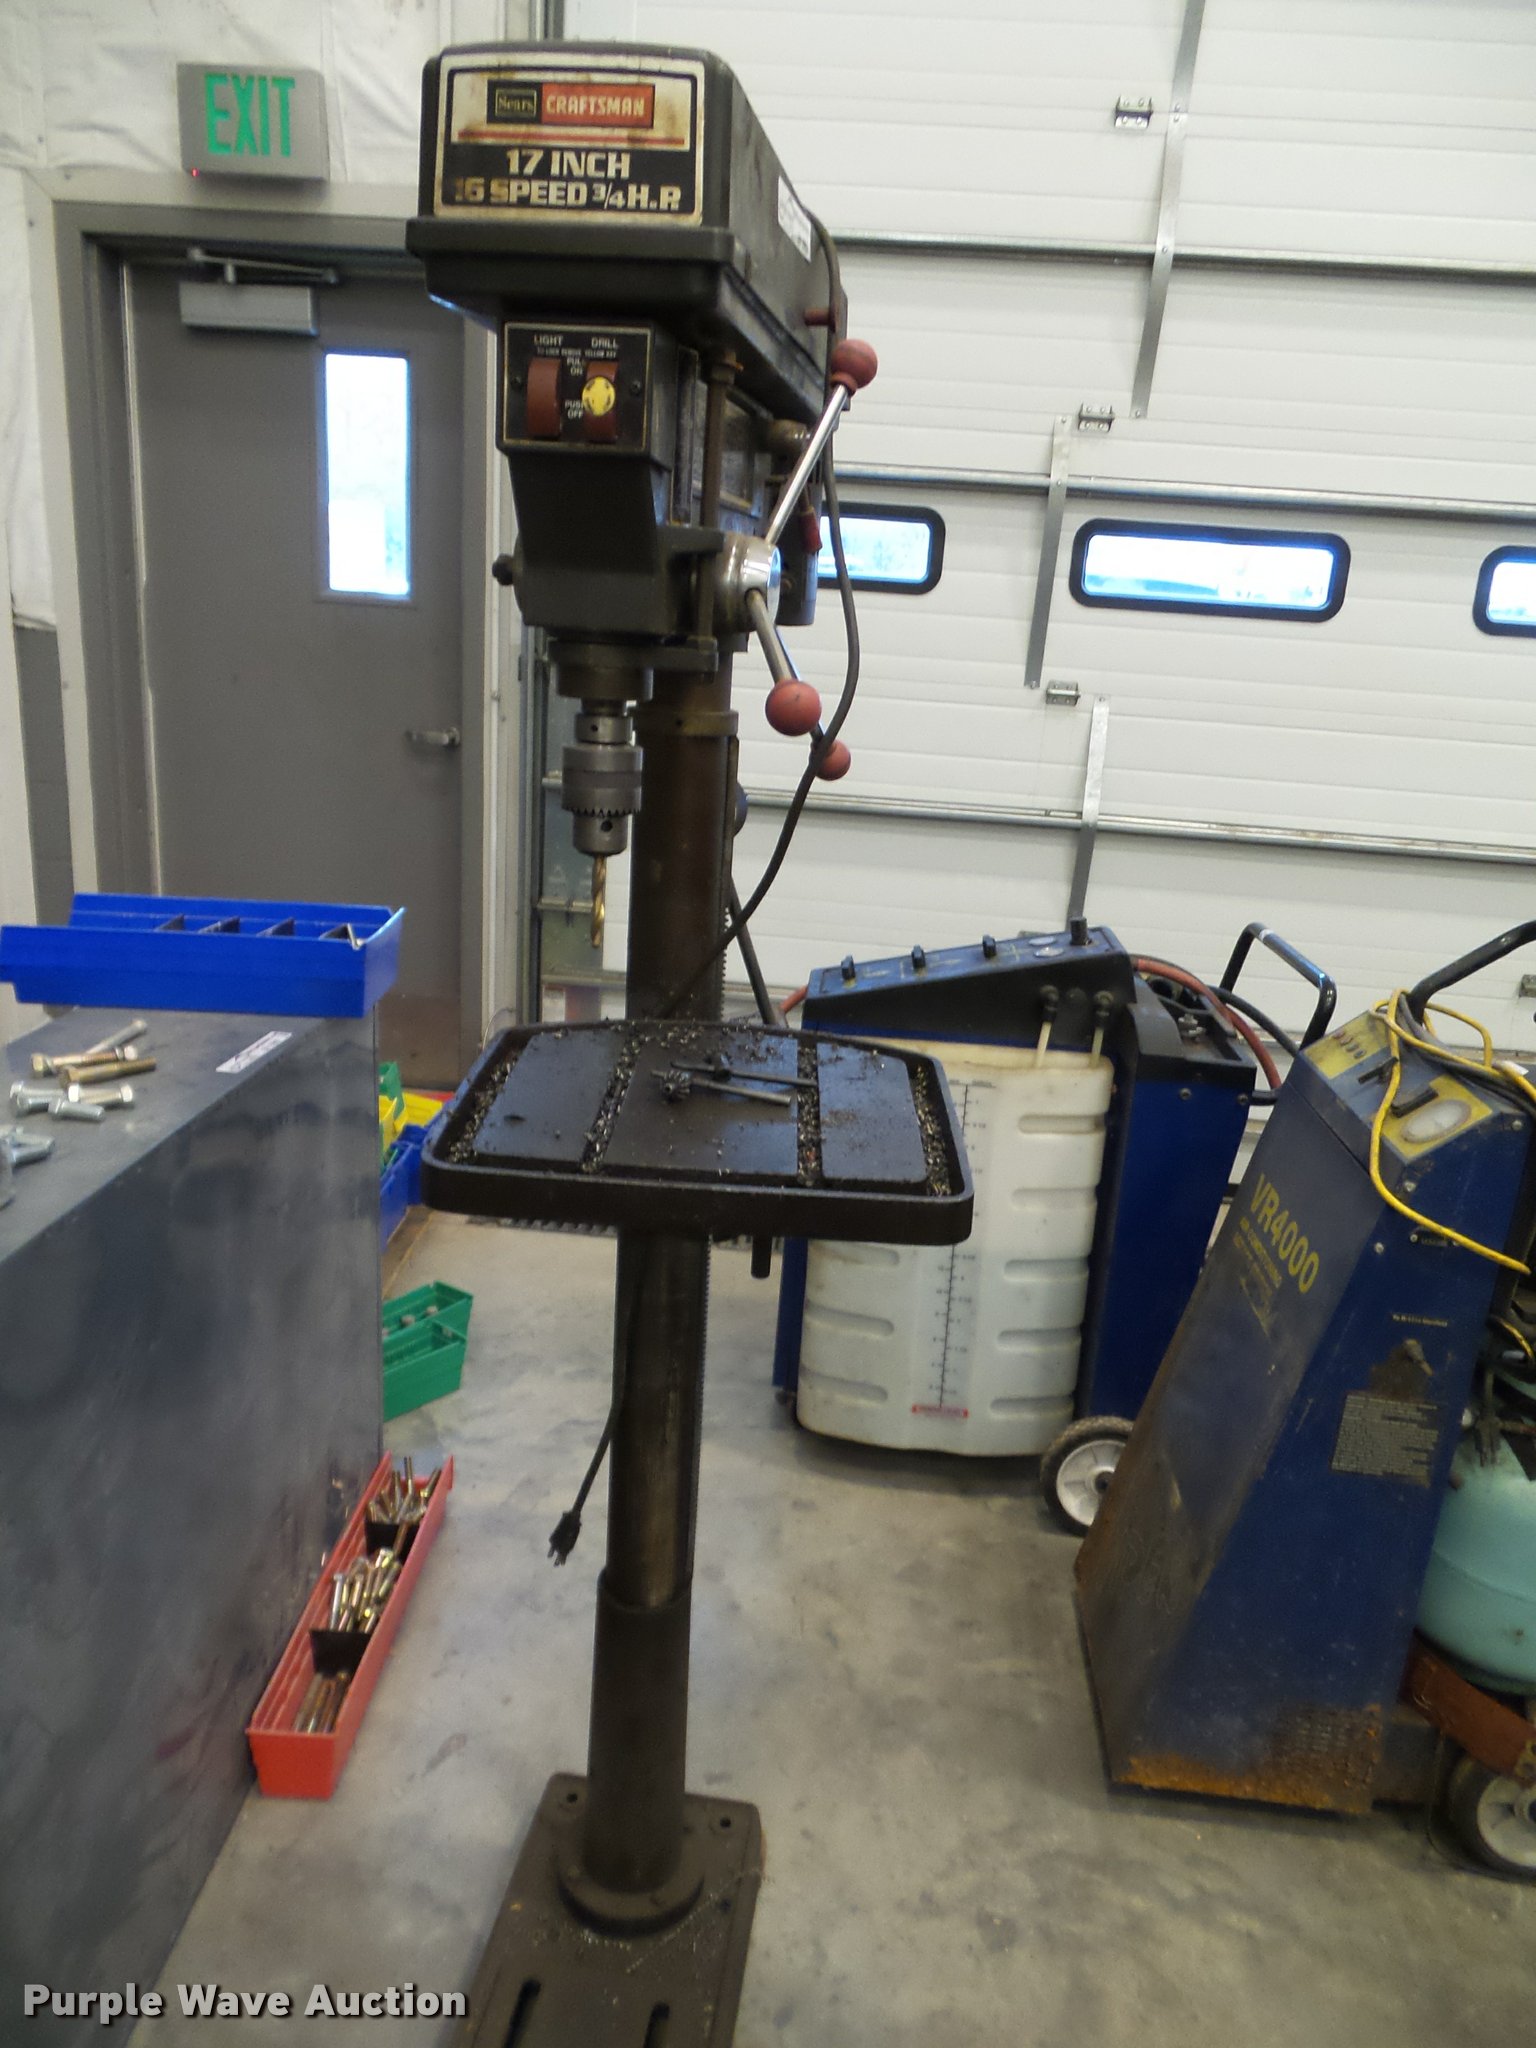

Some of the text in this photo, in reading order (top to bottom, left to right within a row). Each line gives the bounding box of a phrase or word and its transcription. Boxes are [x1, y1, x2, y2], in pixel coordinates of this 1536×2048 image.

[204, 72, 296, 157] EXIT
[498, 94, 645, 116] Sears CRAFTSMAN
[506, 150, 631, 179] 17 INCH
[490, 178, 588, 207] SPEED
[534, 335, 563, 346] LIGHT
[591, 337, 618, 349] DRILL
[570, 367, 583, 376] ON
[567, 408, 583, 419] OFF
[1251, 1173, 1320, 1294] VR4000
